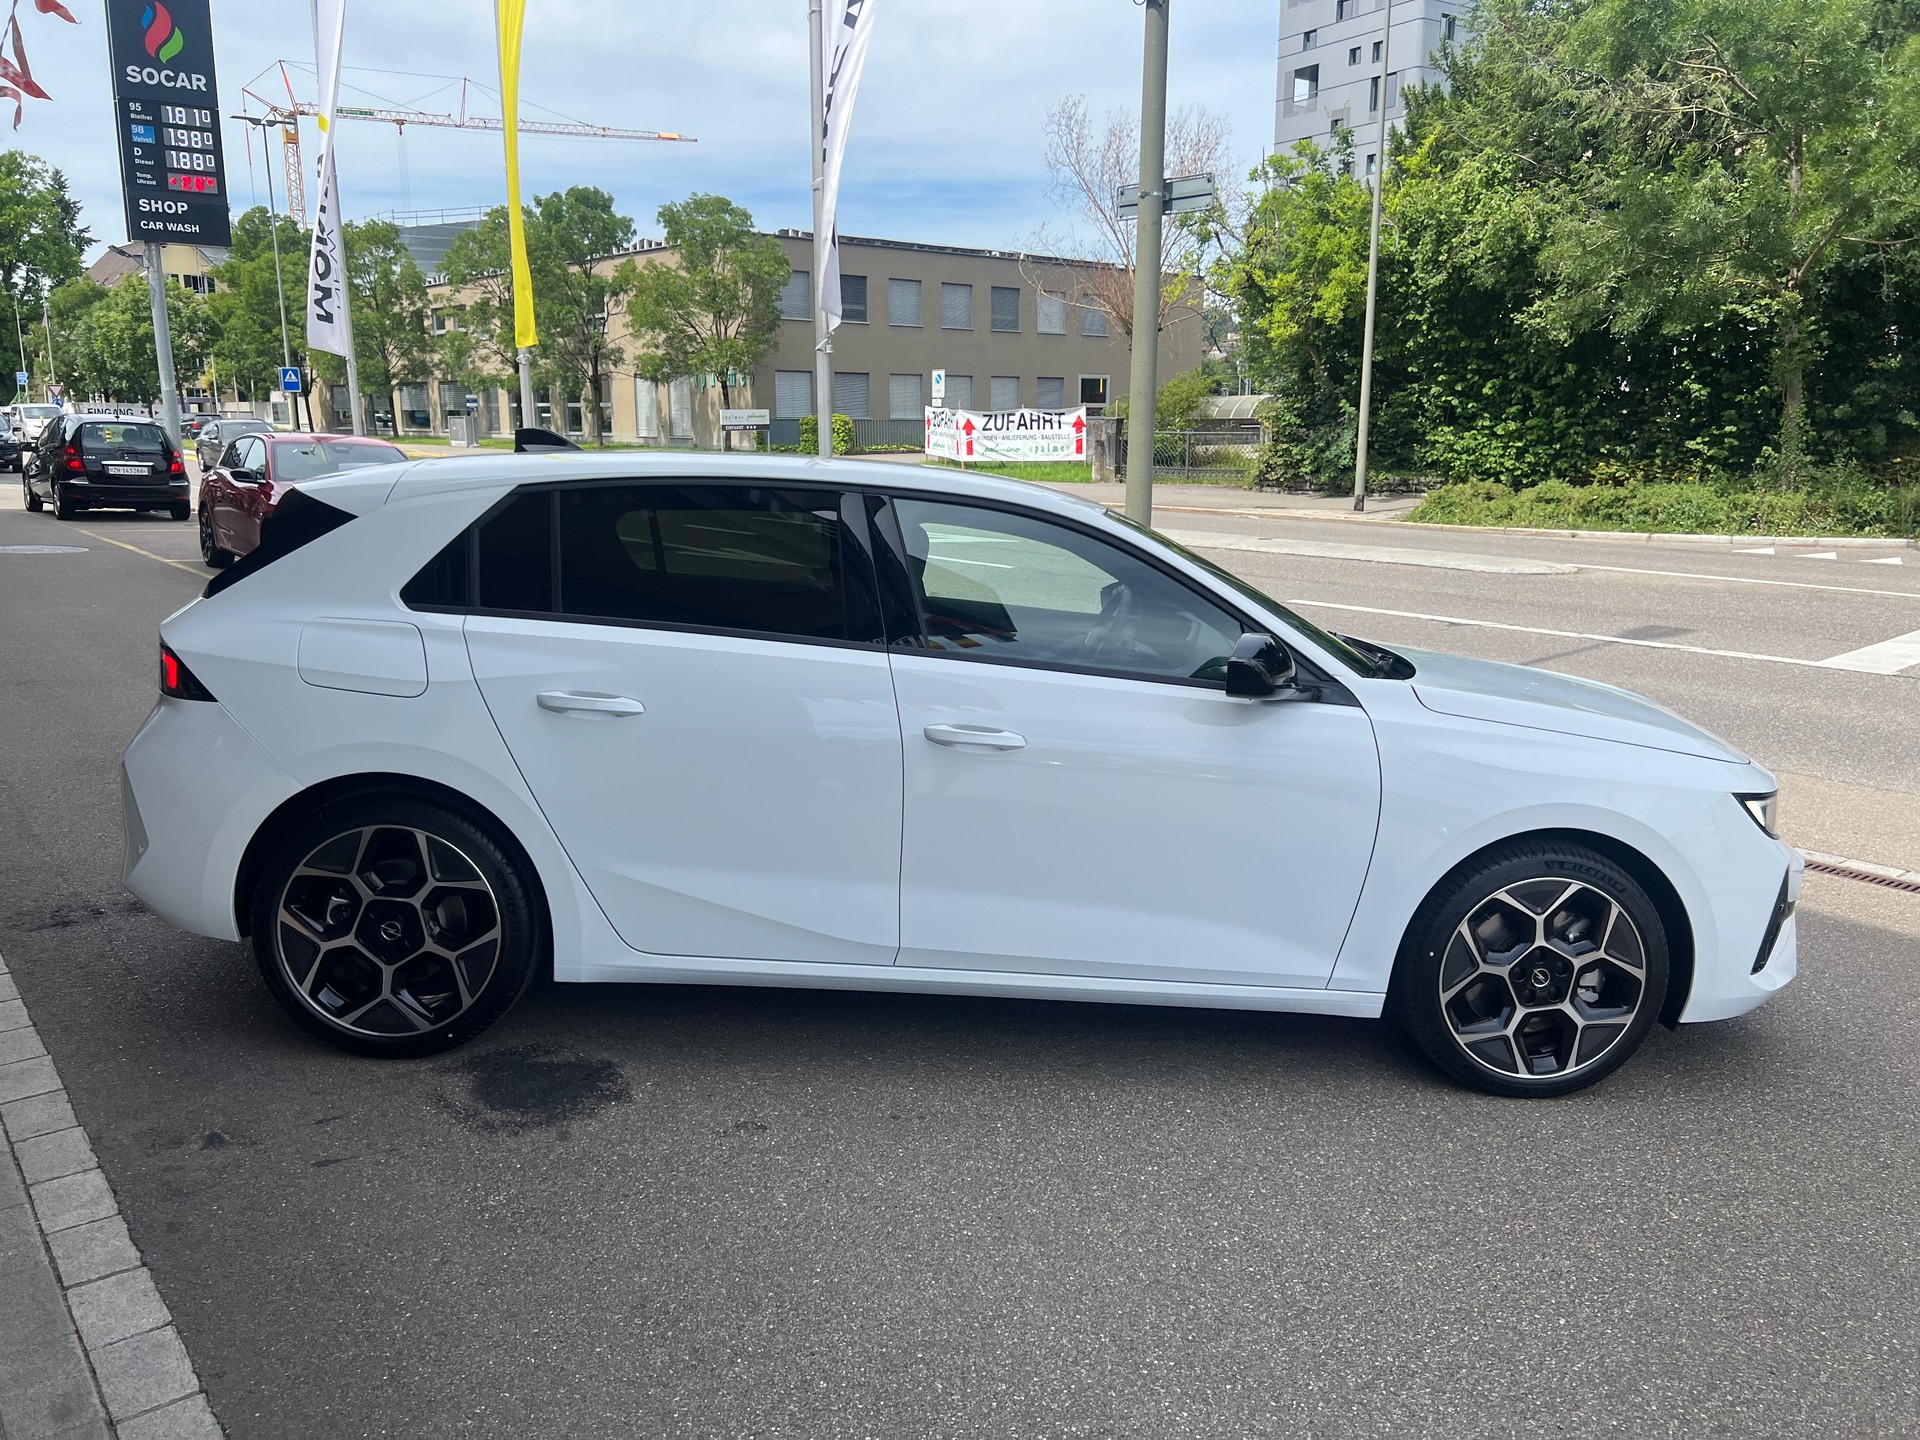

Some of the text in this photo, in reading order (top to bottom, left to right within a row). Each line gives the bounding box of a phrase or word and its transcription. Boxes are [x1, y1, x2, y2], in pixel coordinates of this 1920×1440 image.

[126, 65, 207, 92] SOCAR
[129, 102, 142, 111] 95
[130, 113, 153, 121] Bleifrei
[131, 125, 144, 134] 98
[133, 147, 142, 156] D
[138, 198, 188, 214] SHOP
[140, 220, 199, 233] CAR WASH
[982, 412, 1066, 432] ZUFAHRT
